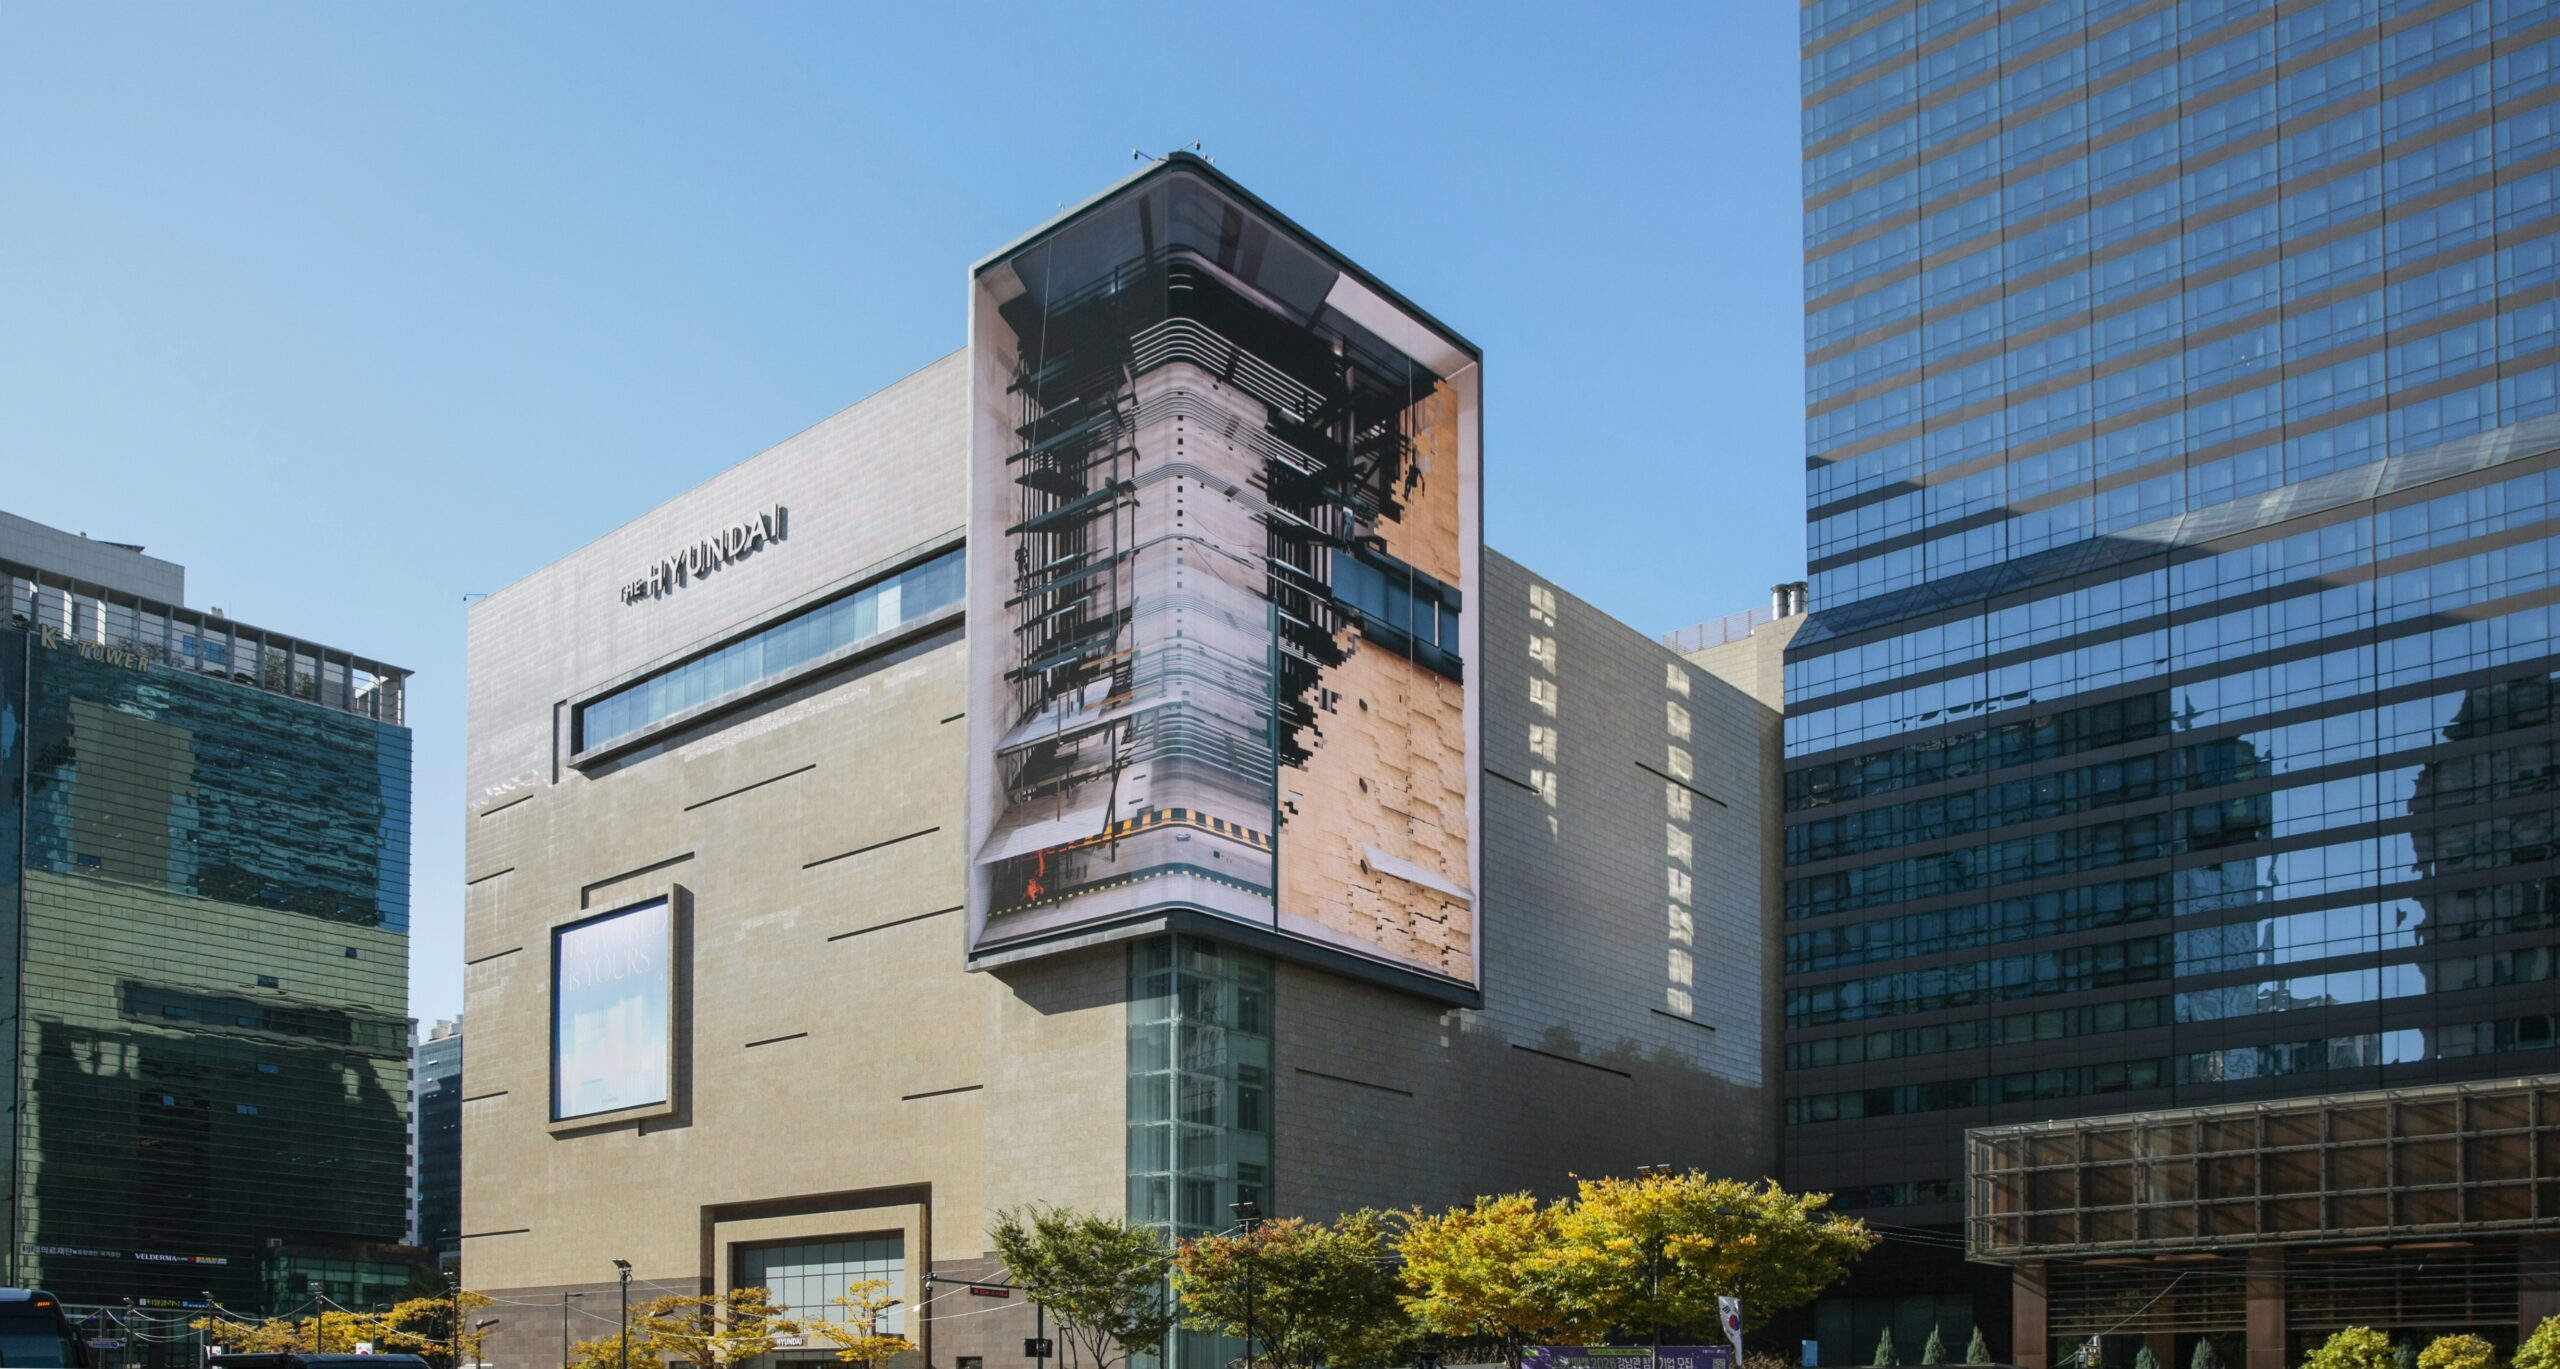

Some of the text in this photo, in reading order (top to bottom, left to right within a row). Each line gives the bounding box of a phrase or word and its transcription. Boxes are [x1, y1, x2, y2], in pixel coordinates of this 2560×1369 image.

[620, 503, 780, 604] THE HYUNDAI
[594, 908, 668, 949] WRLD
[583, 946, 651, 987] YOURS
[134, 1252, 177, 1262] VELDERMA
[776, 1337, 803, 1346] HYUNDAI
[1617, 1357, 1641, 1369] 강남관
[1677, 1357, 1693, 1369] 모집
